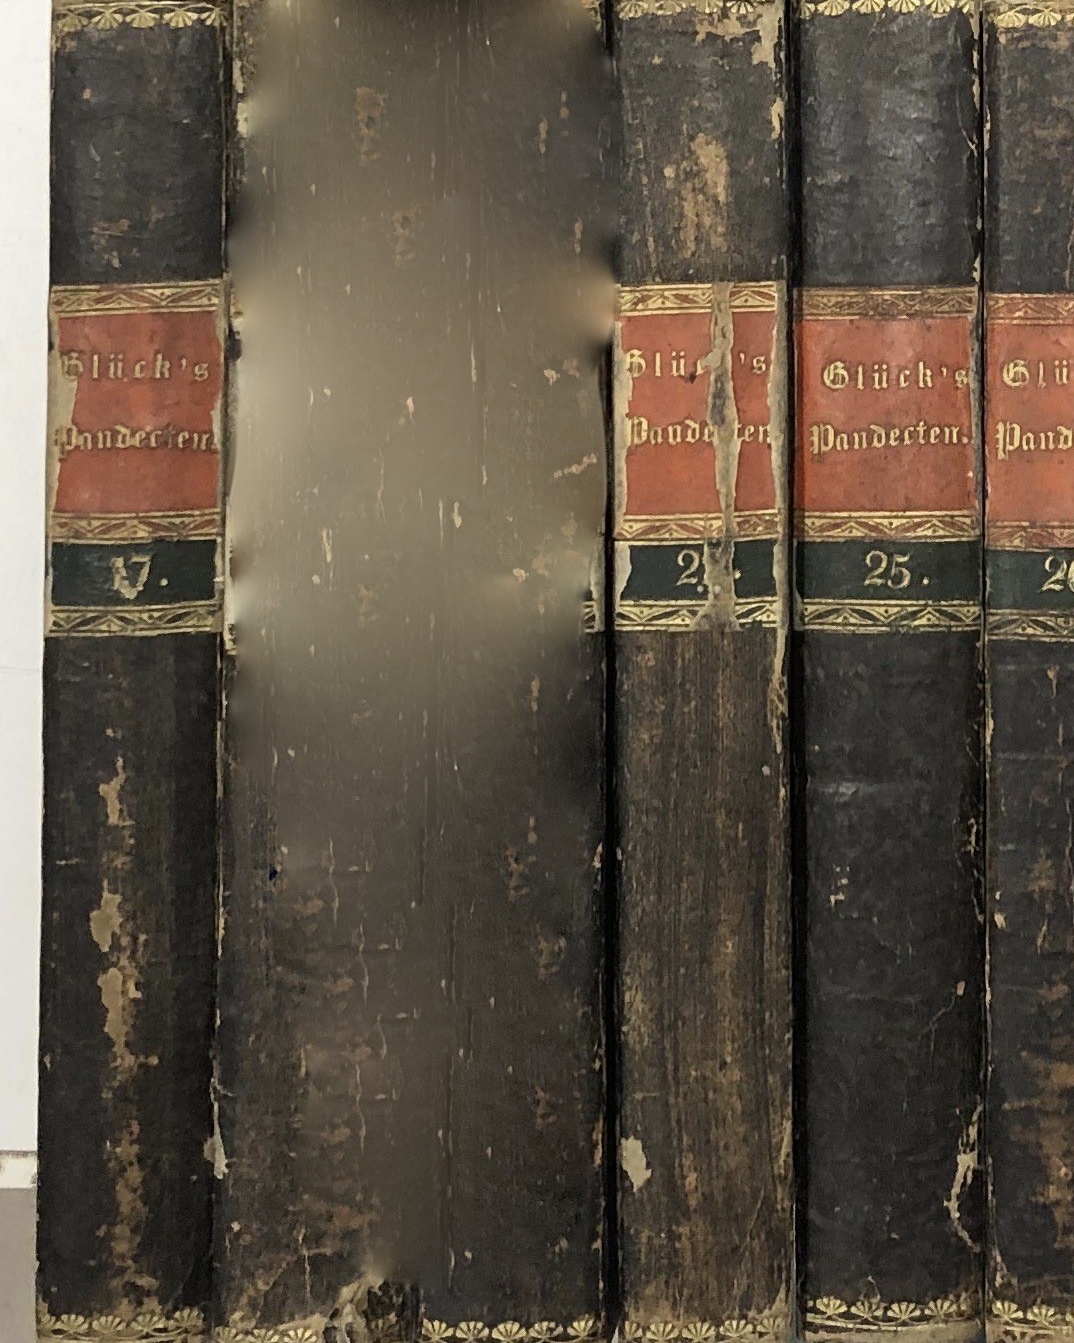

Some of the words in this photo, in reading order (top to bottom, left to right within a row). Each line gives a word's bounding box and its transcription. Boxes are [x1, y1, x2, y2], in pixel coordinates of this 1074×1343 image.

[823, 361, 974, 391] Glück's
[809, 422, 970, 455] Pandecten.
[864, 550, 930, 590] 25.
